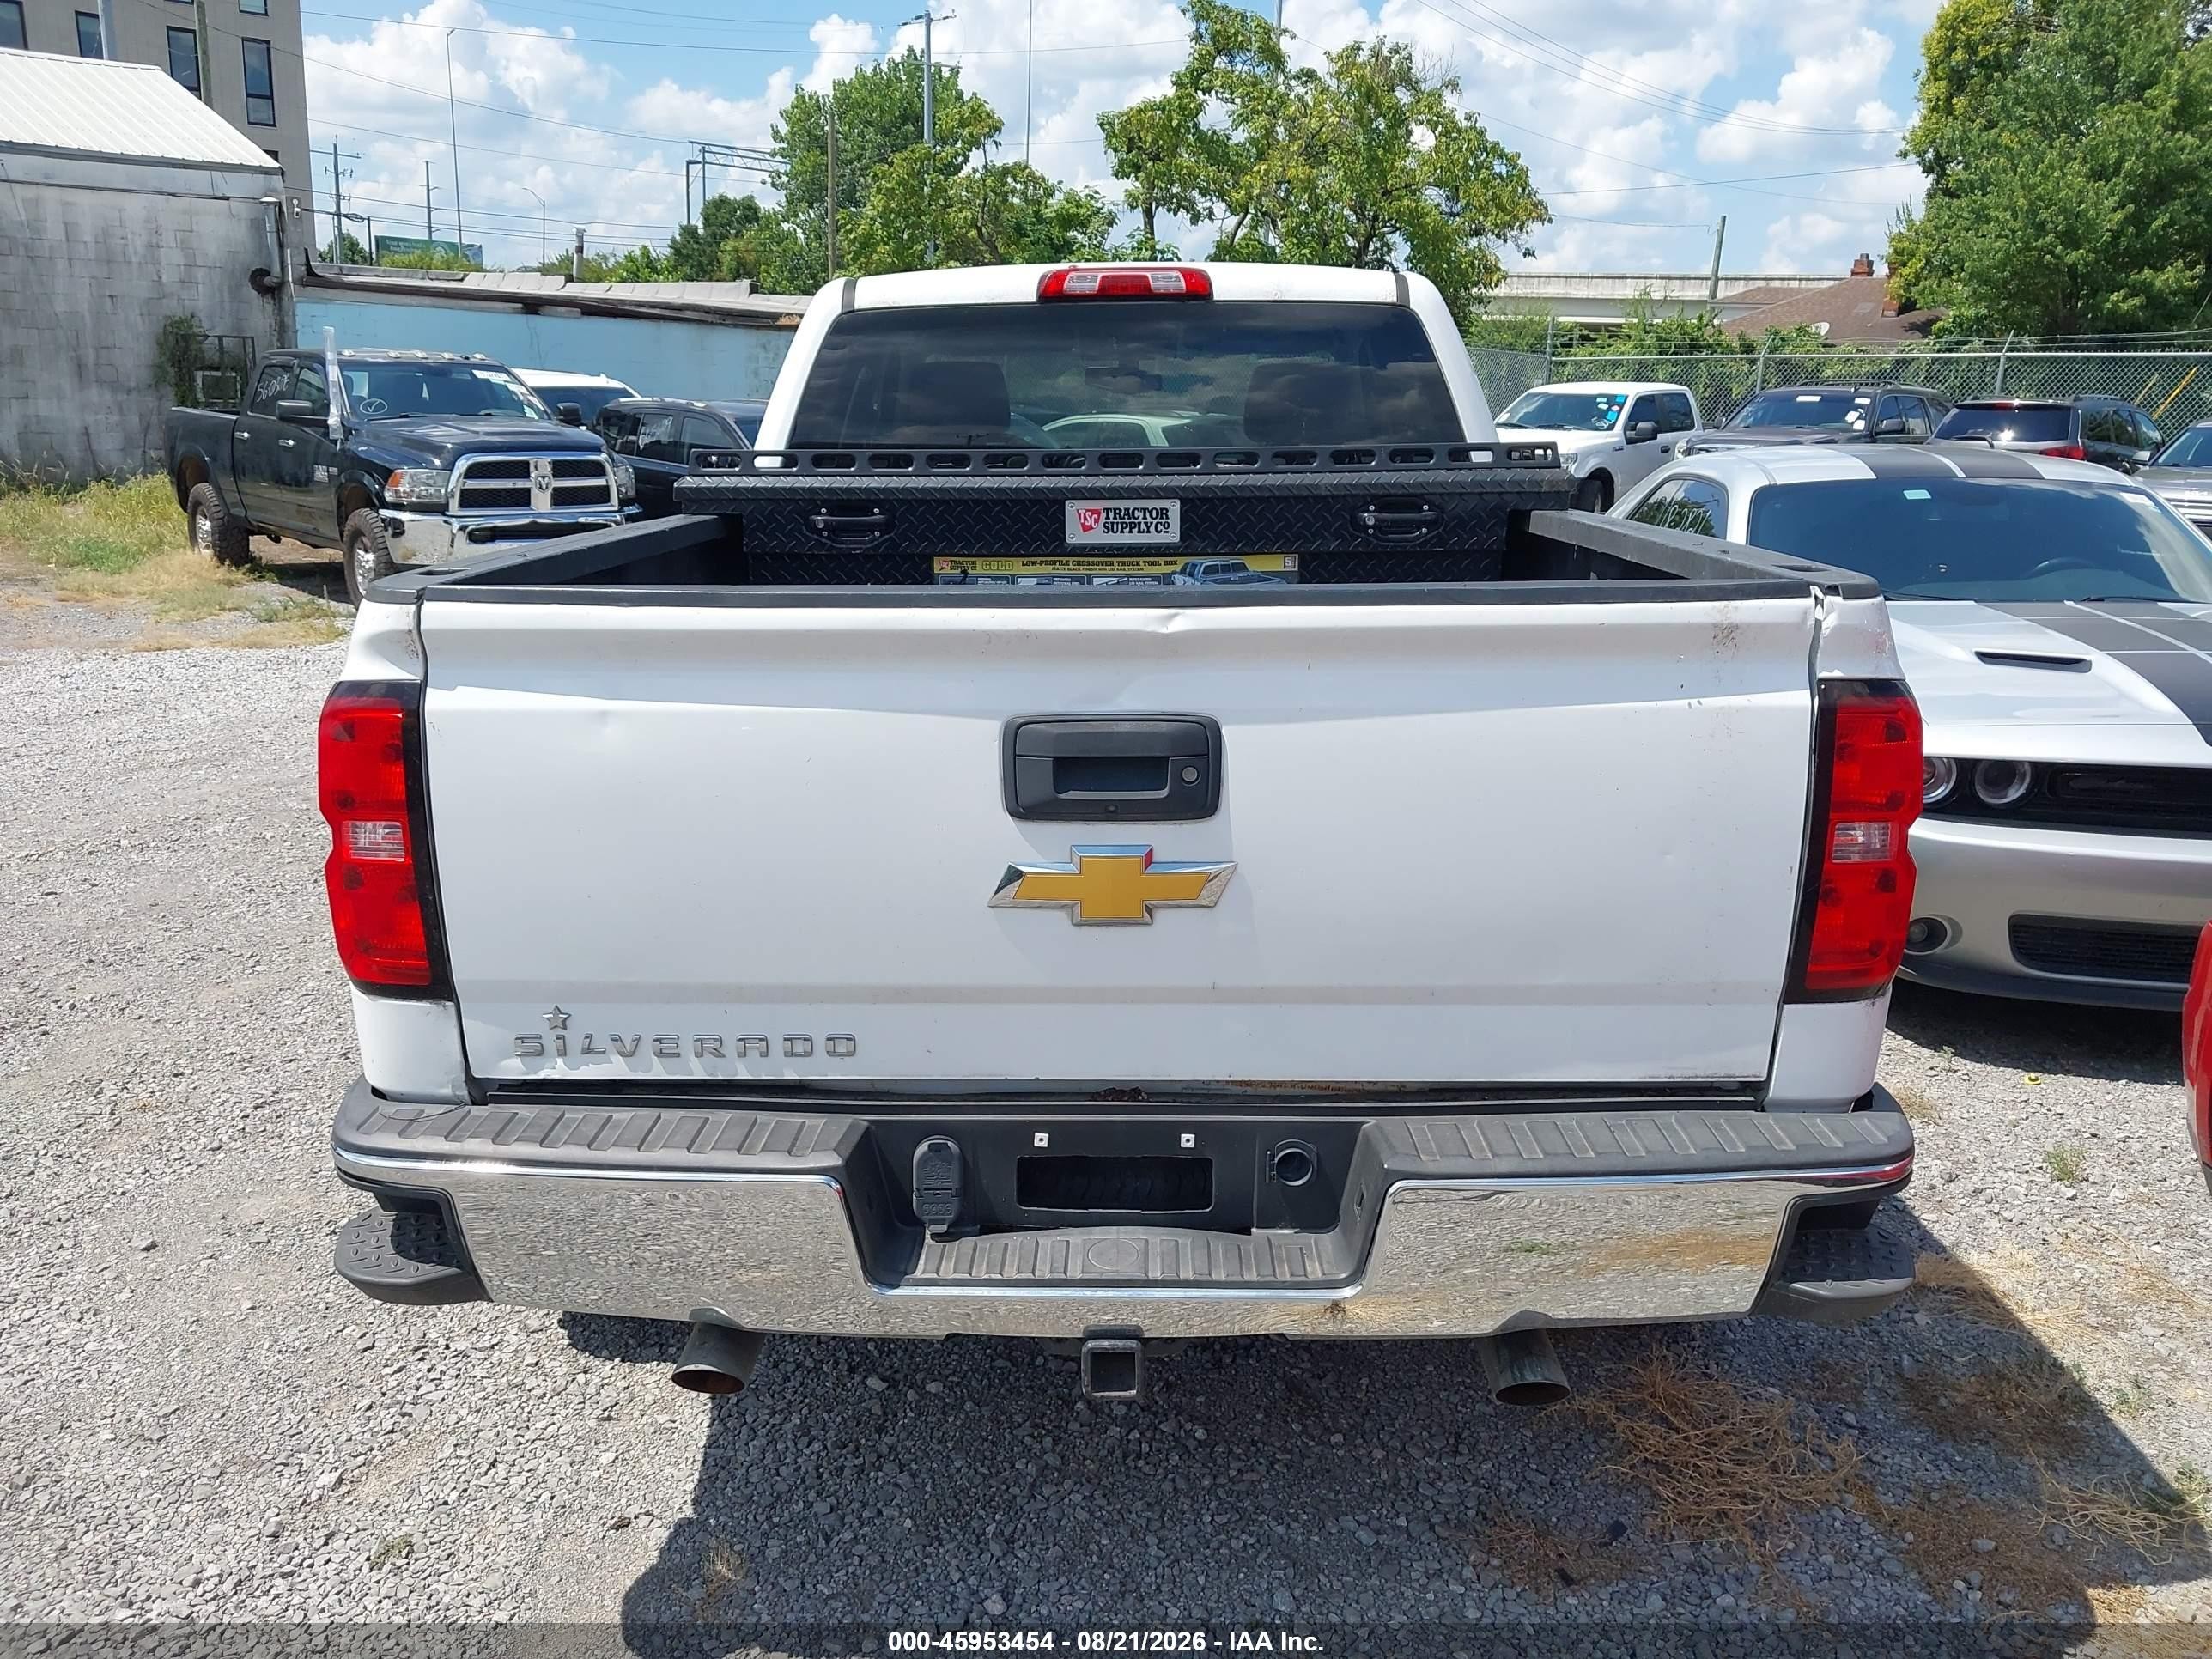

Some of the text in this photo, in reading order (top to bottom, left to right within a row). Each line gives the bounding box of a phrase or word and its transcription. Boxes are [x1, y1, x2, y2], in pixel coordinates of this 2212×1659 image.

[1079, 509, 1098, 529] TSC
[1103, 507, 1170, 520] TRACTOR
[1103, 521, 1153, 534] SUPPLY
[982, 560, 1013, 570] GOLD
[514, 1032, 857, 1059] SILVERADO
